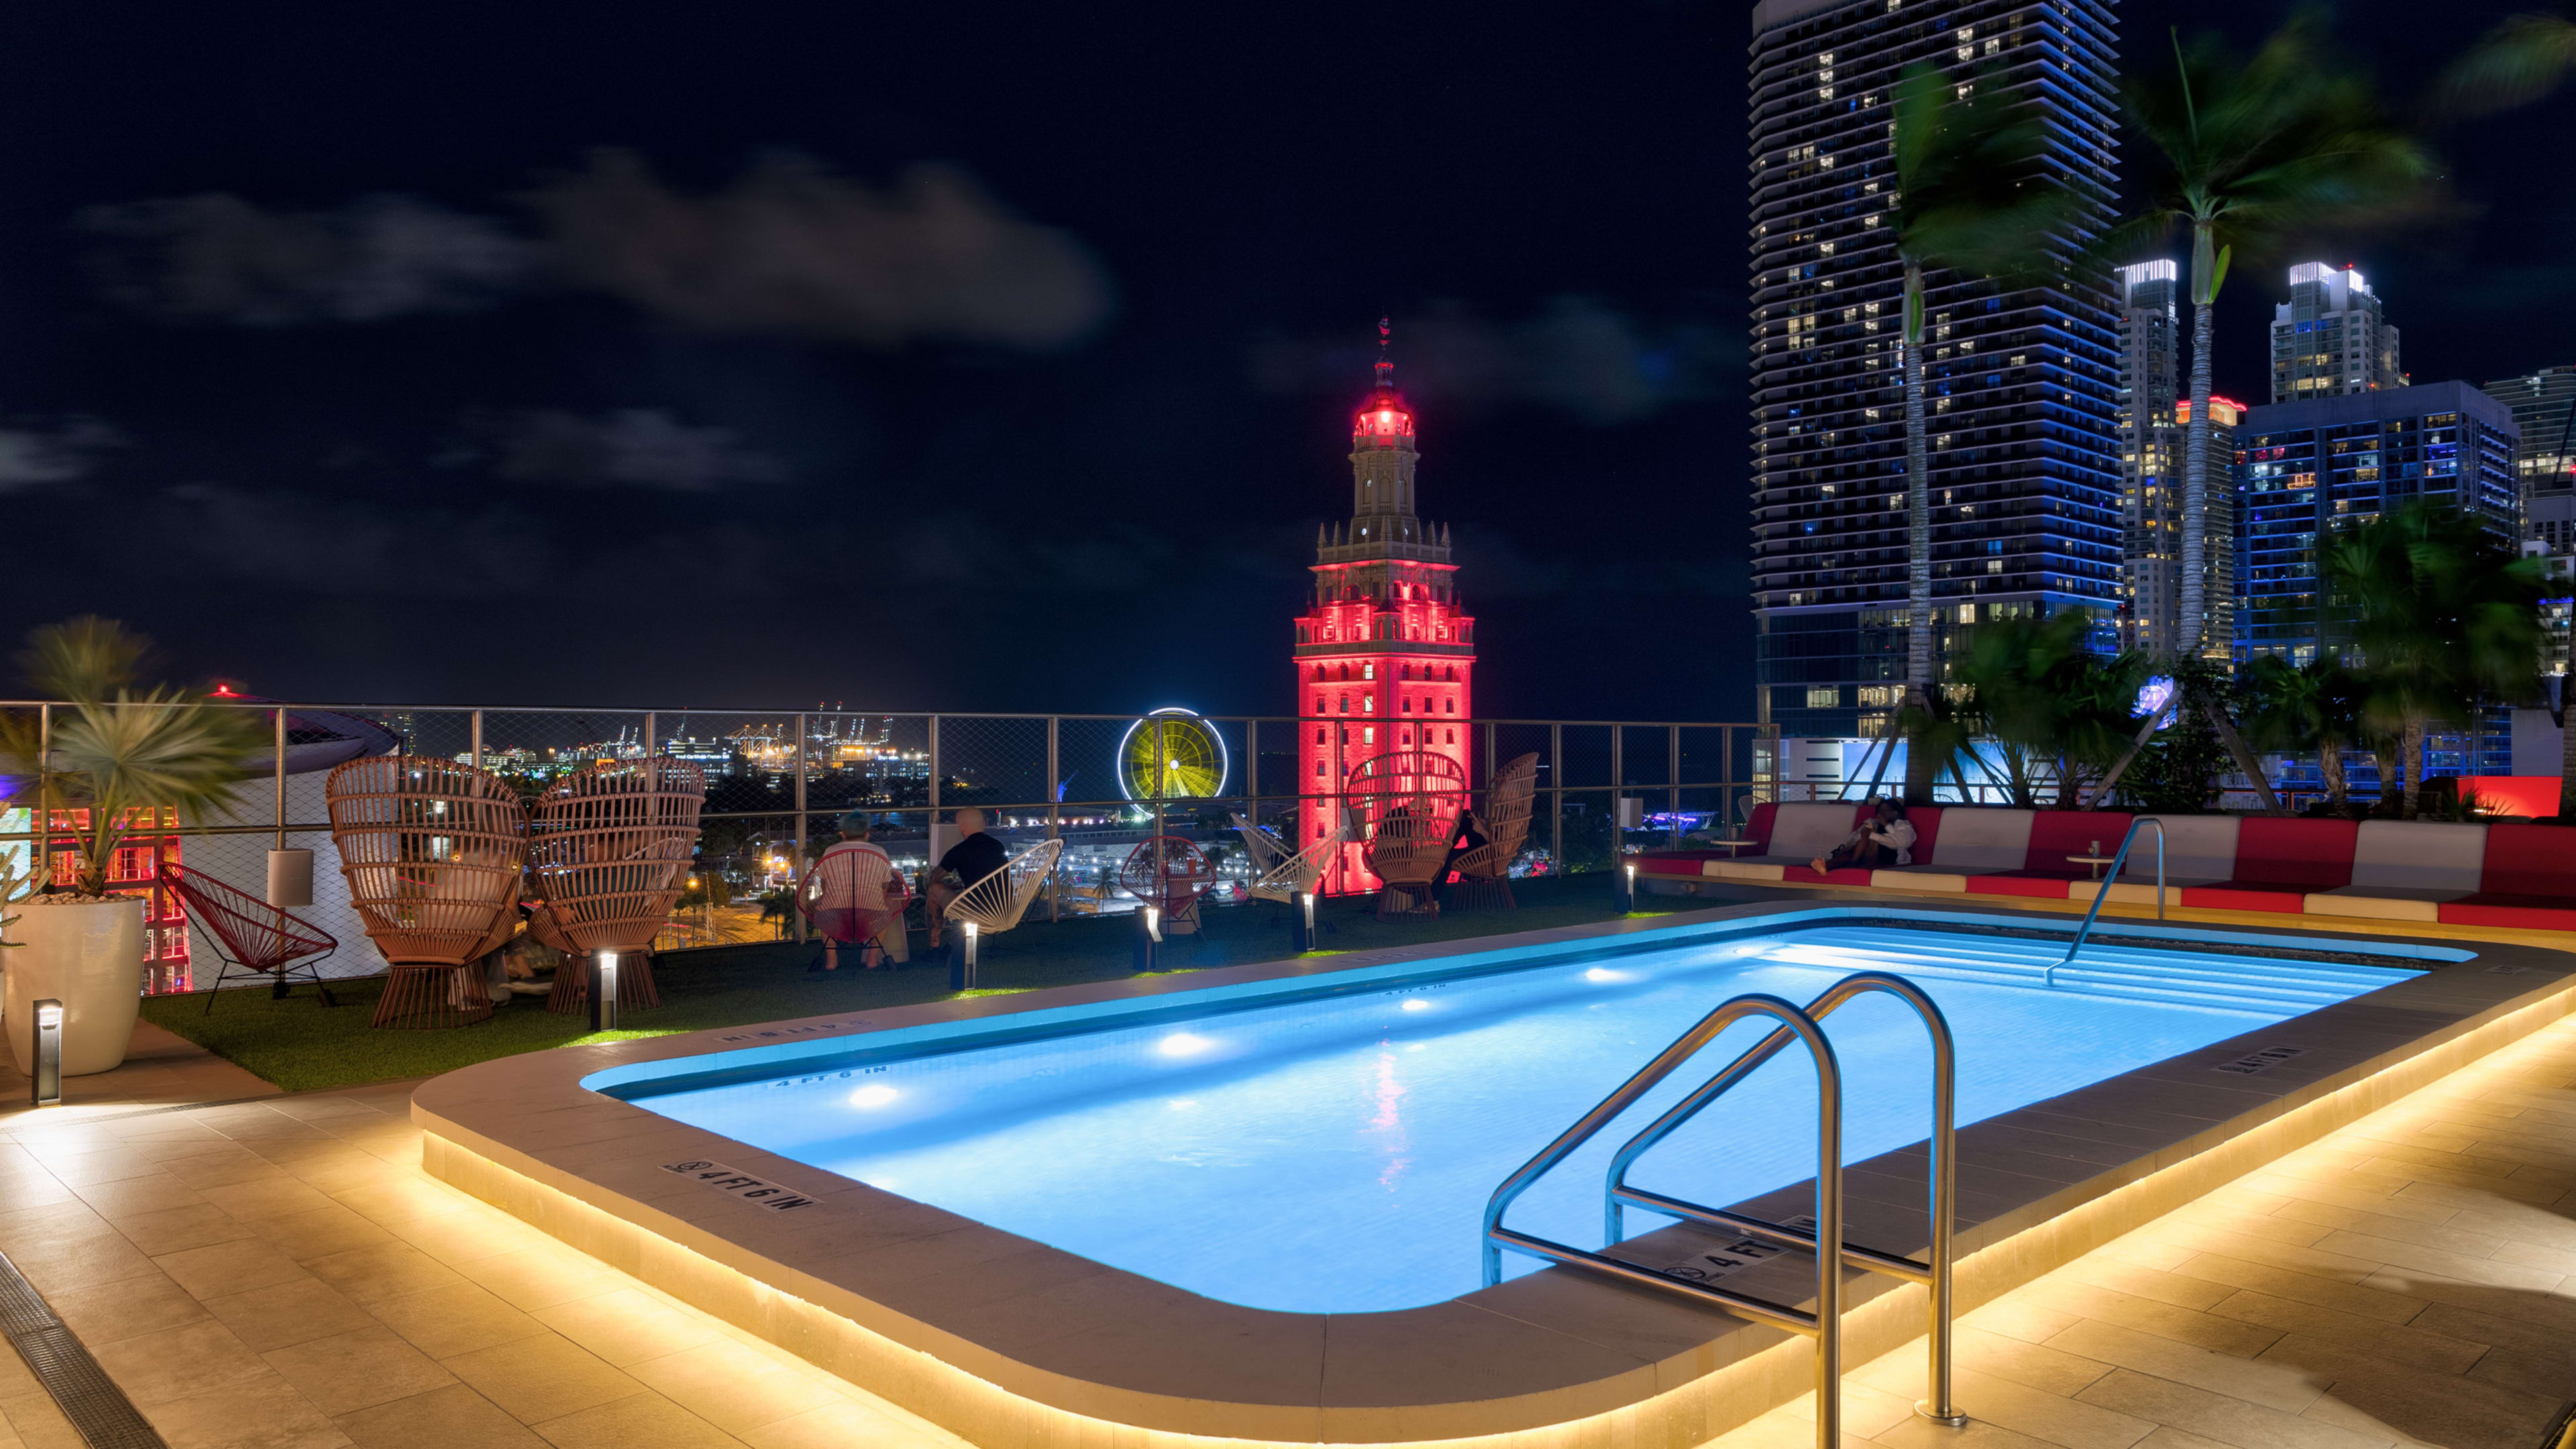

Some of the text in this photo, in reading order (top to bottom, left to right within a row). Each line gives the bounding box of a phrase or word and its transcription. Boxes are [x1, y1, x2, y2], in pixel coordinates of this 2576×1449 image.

[801, 1075, 828, 1084] FT
[865, 1066, 887, 1074] IN
[698, 1171, 814, 1210] 4 FT 6 IN
[1723, 1240, 1781, 1258] FT
[1705, 1254, 1745, 1267] 4
